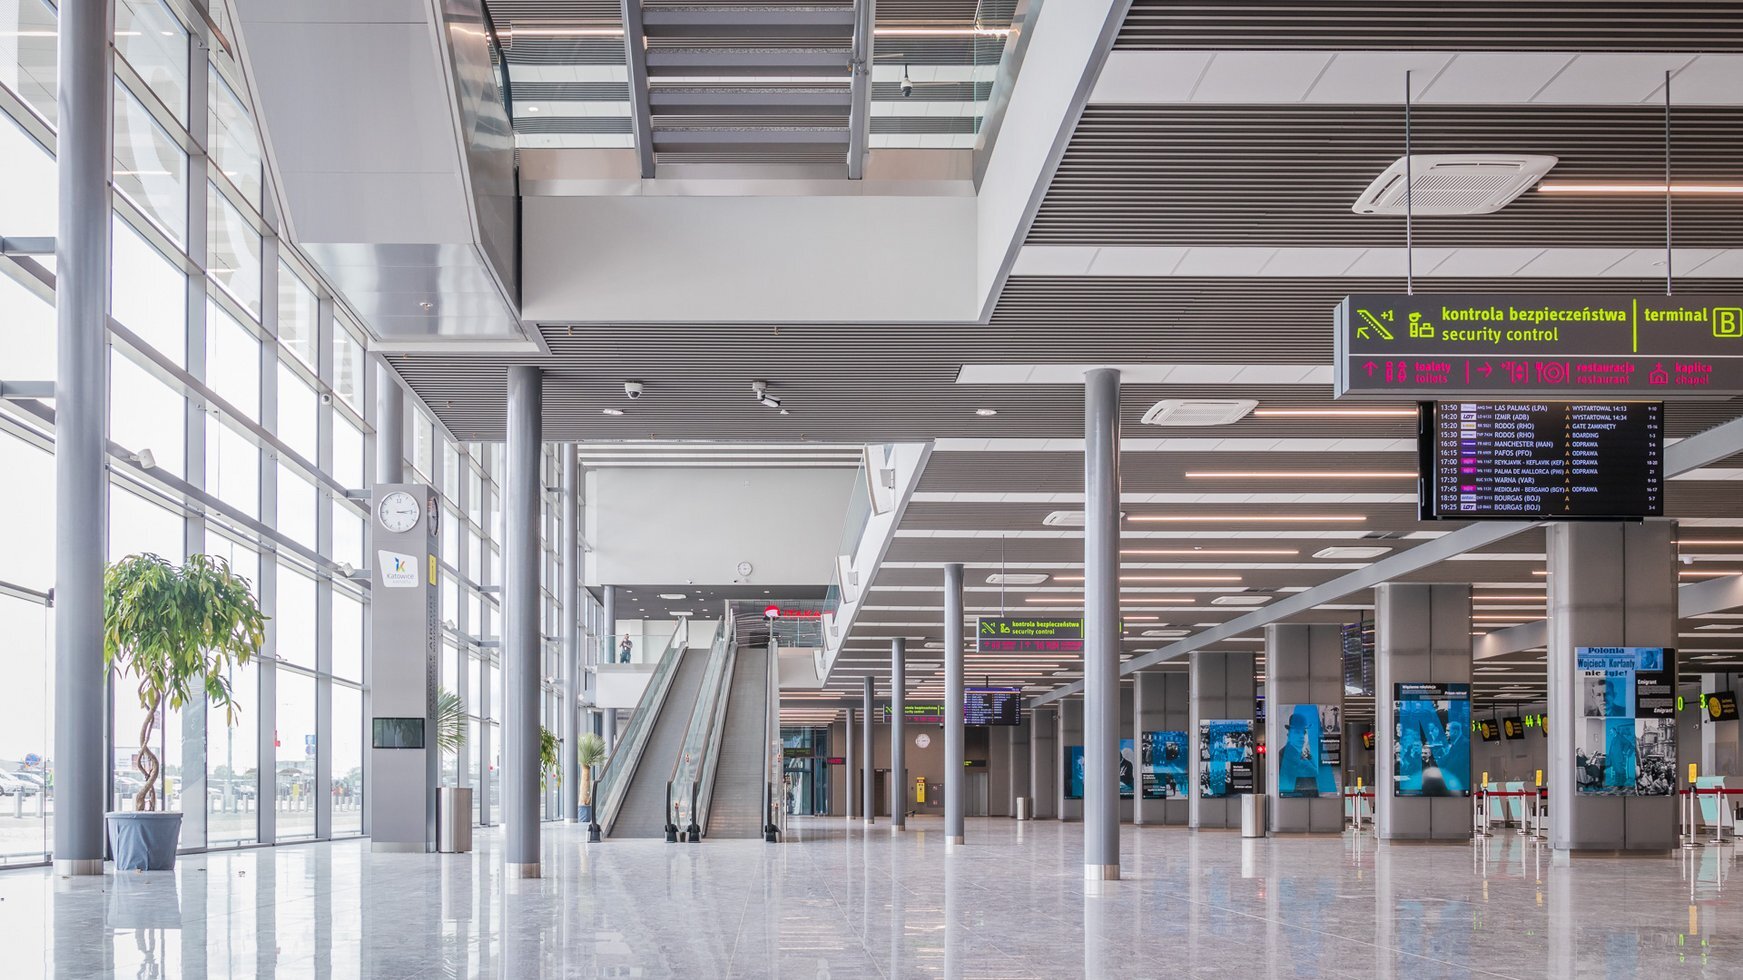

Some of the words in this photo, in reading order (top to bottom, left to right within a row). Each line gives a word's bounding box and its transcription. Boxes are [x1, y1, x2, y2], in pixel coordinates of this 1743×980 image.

[1442, 306, 1504, 321] kontrola
[1509, 306, 1626, 324] bezpieczeństwa
[1644, 307, 1708, 322] terminal
[1720, 311, 1736, 334] B
[1442, 326, 1501, 344] security
[1506, 326, 1558, 341] control
[1675, 361, 1712, 374] kaplica
[1414, 373, 1448, 384] toilets
[1675, 374, 1708, 386] chapel
[1578, 658, 1606, 669] Wojciech
